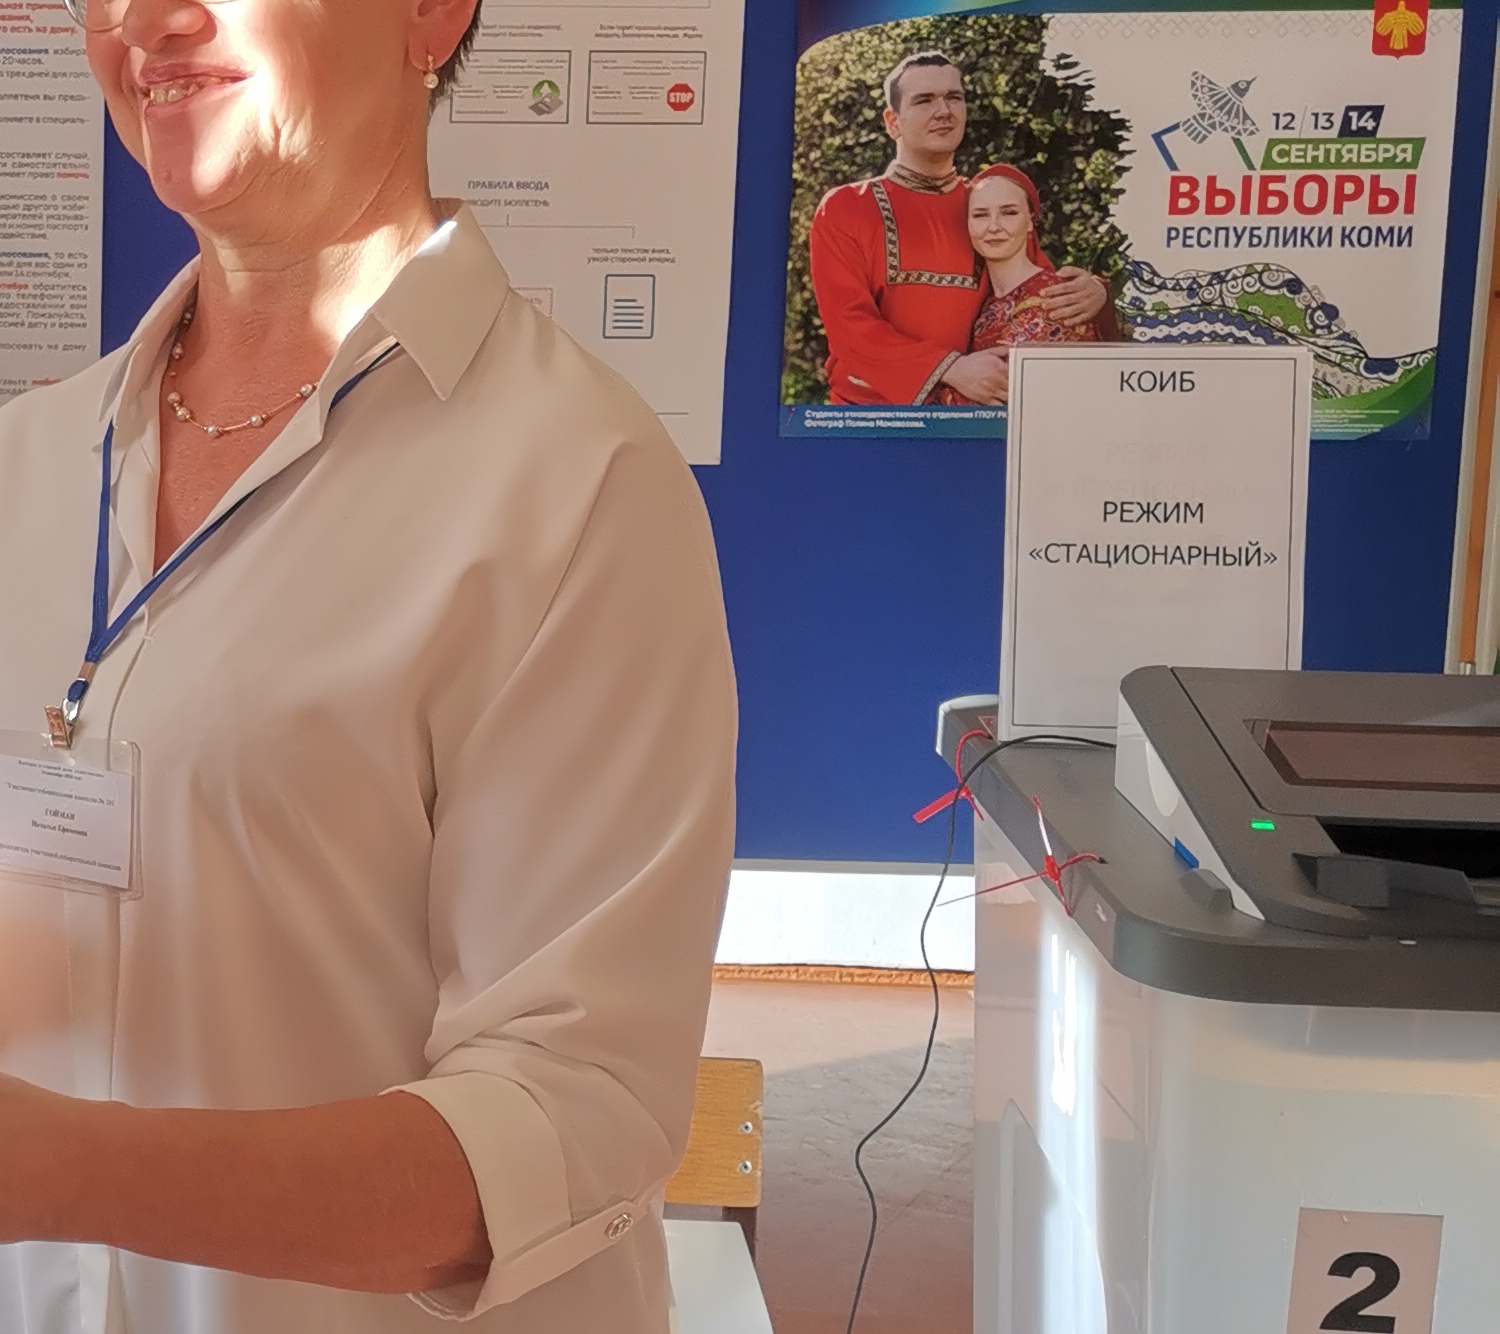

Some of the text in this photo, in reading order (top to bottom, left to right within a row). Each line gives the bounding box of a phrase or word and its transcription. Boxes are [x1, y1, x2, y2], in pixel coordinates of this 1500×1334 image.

[669, 91, 693, 104] STOP
[1272, 110, 1377, 132] 12 13 14
[1270, 142, 1415, 164] СЕНТЯБРЯ
[467, 180, 550, 191] ПРАВИЛА ВВОДА
[1168, 173, 1418, 216] ВЫБОРЫ
[1165, 224, 1415, 249] РЕСПУБЛИКИ КОМИ
[1119, 370, 1196, 393] КОИБ
[1102, 501, 1205, 525] РЕЖИМ
[1028, 540, 1278, 569] «СТАЦИОНАРНЫЙ»
[1318, 1251, 1401, 1334] 2
